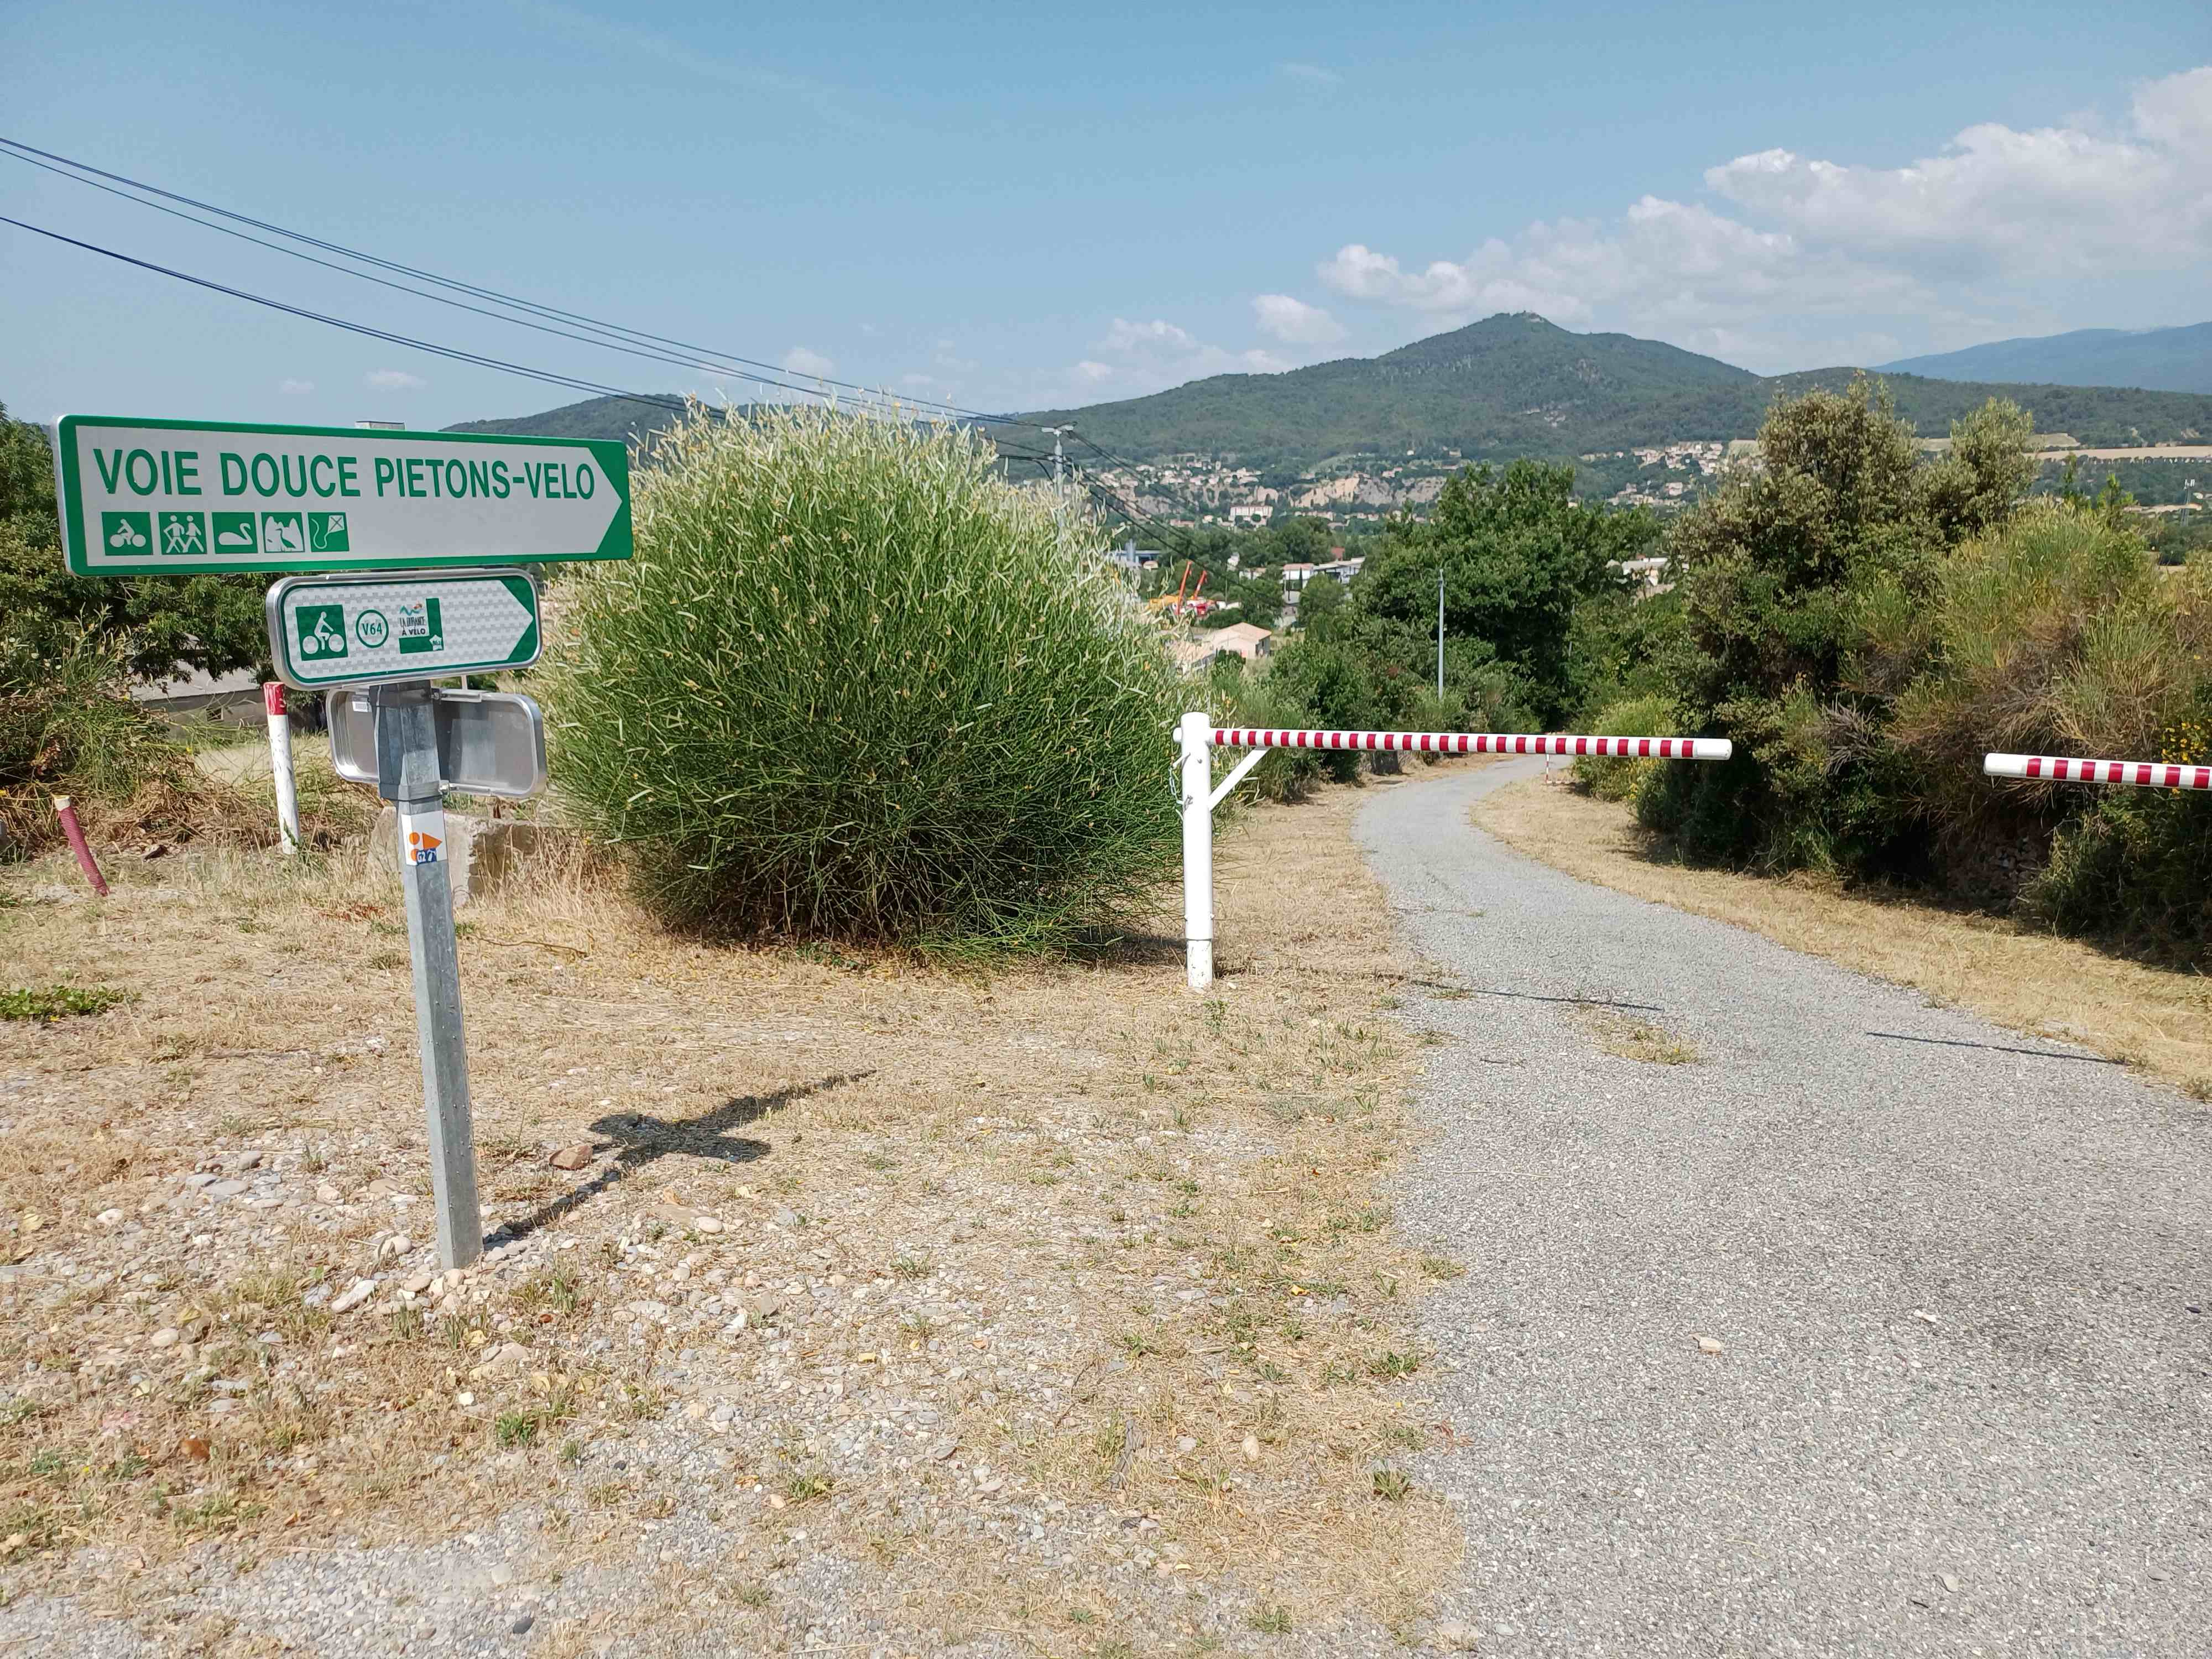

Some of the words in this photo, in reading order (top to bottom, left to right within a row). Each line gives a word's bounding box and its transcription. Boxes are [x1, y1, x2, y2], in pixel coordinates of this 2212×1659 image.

[93, 448, 201, 495] VOIE
[221, 452, 361, 498] DOUCE
[375, 457, 595, 500] PIETONS-VELO
[362, 622, 383, 636] V64
